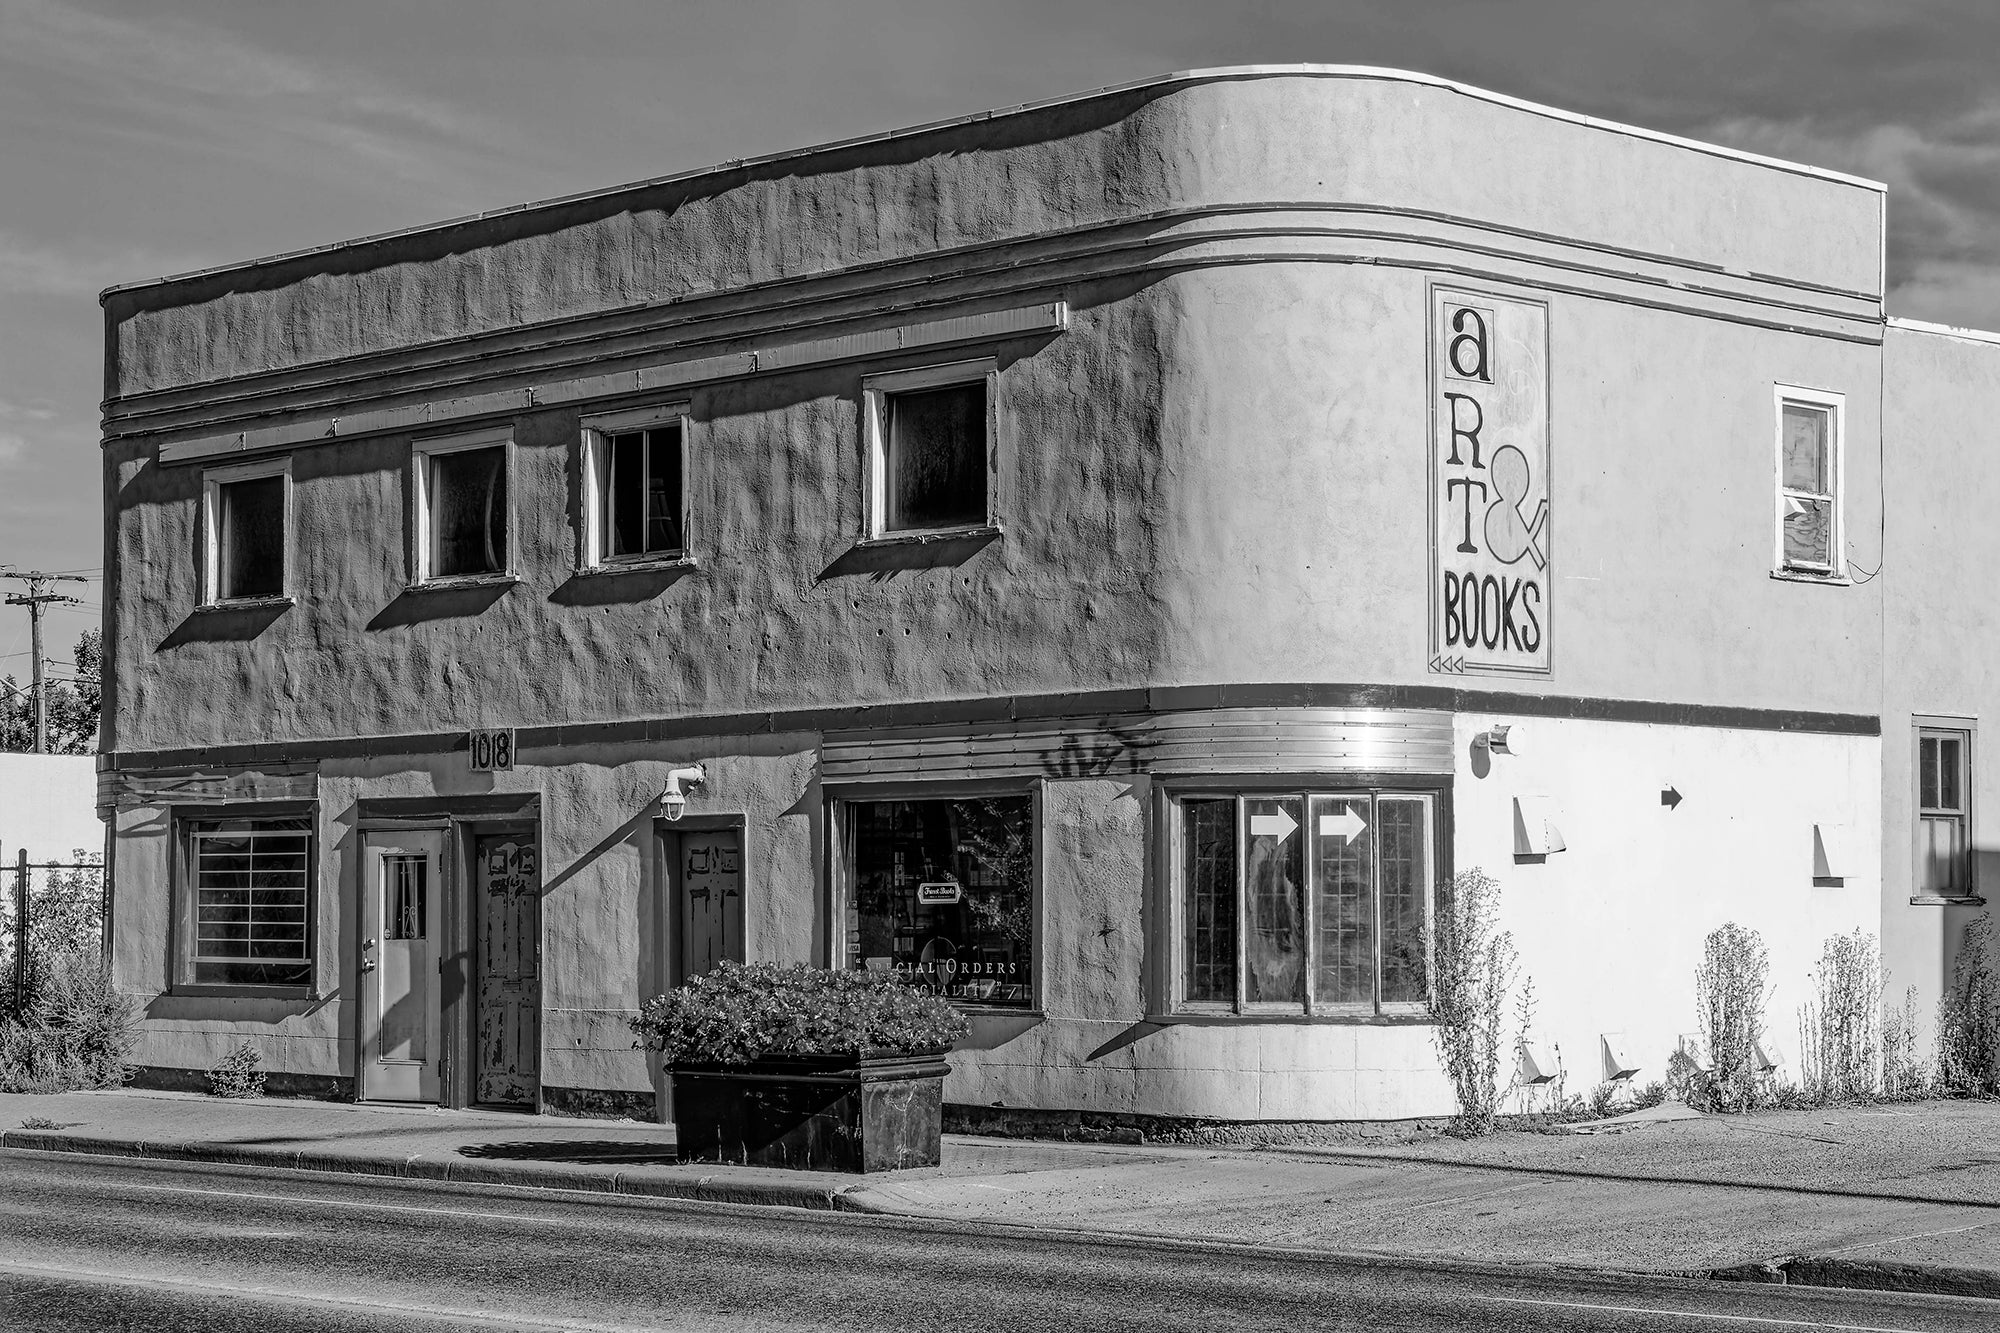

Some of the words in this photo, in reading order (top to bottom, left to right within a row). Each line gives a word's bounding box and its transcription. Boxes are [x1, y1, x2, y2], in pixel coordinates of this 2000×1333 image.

[1484, 444, 1548, 571] &
[1444, 570, 1541, 653] BOOKS
[471, 732, 510, 769] 1018
[946, 958, 1016, 974] ORDERS
